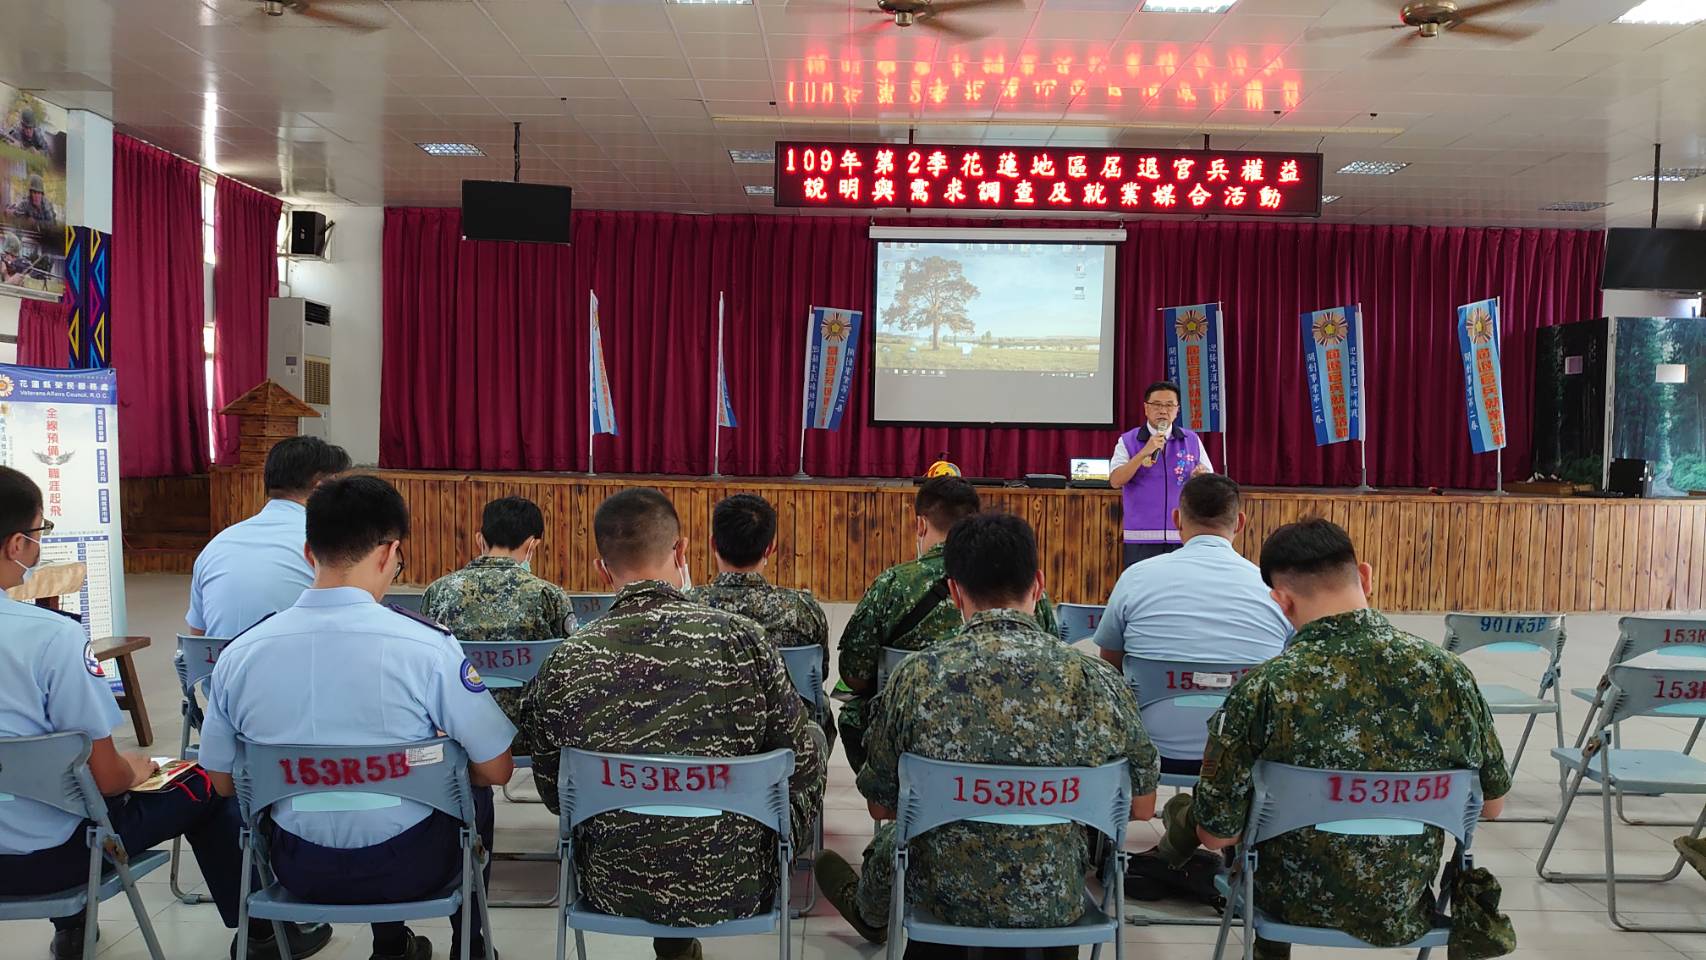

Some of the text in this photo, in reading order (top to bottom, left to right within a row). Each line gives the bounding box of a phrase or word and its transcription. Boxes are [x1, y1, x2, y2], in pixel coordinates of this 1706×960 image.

[785, 149, 1300, 183] 109年第2季花蓮地區屆退官兵權益
[803, 176, 1282, 209] 說明與需求調查及就業媒合活動
[278, 751, 410, 786] 153R5B
[600, 757, 734, 792] 153R5B
[952, 776, 1081, 806] 153R5B
[1328, 774, 1452, 804] 153R5B
